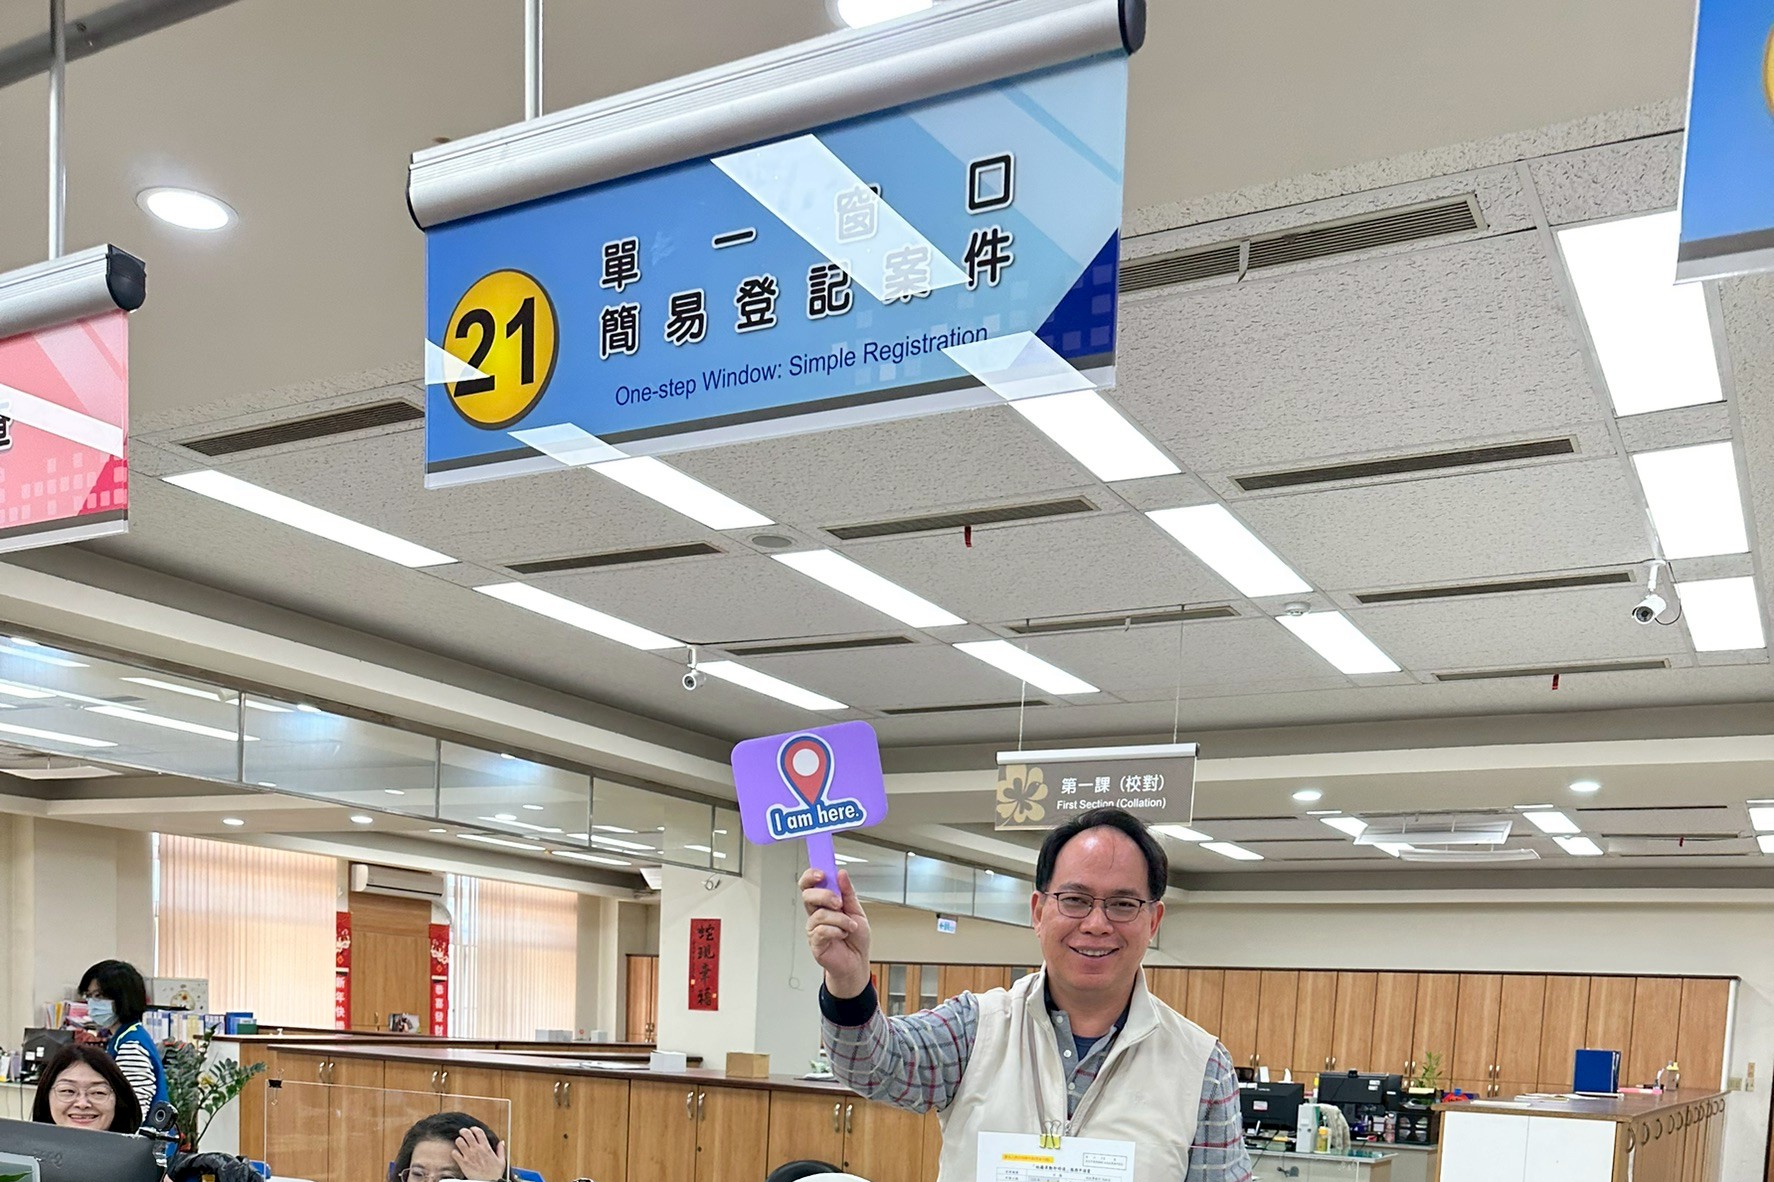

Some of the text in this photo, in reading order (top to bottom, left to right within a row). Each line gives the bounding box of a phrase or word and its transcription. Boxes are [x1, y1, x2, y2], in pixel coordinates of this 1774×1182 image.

[601, 153, 1013, 288] 單一窗口
[600, 229, 1013, 357] 簡易登記案件
[453, 297, 535, 398] 21
[615, 326, 988, 406] One-step Window: Simple Registration
[775, 804, 859, 832] I am here.
[1057, 797, 1166, 809] First Section (Collation)
